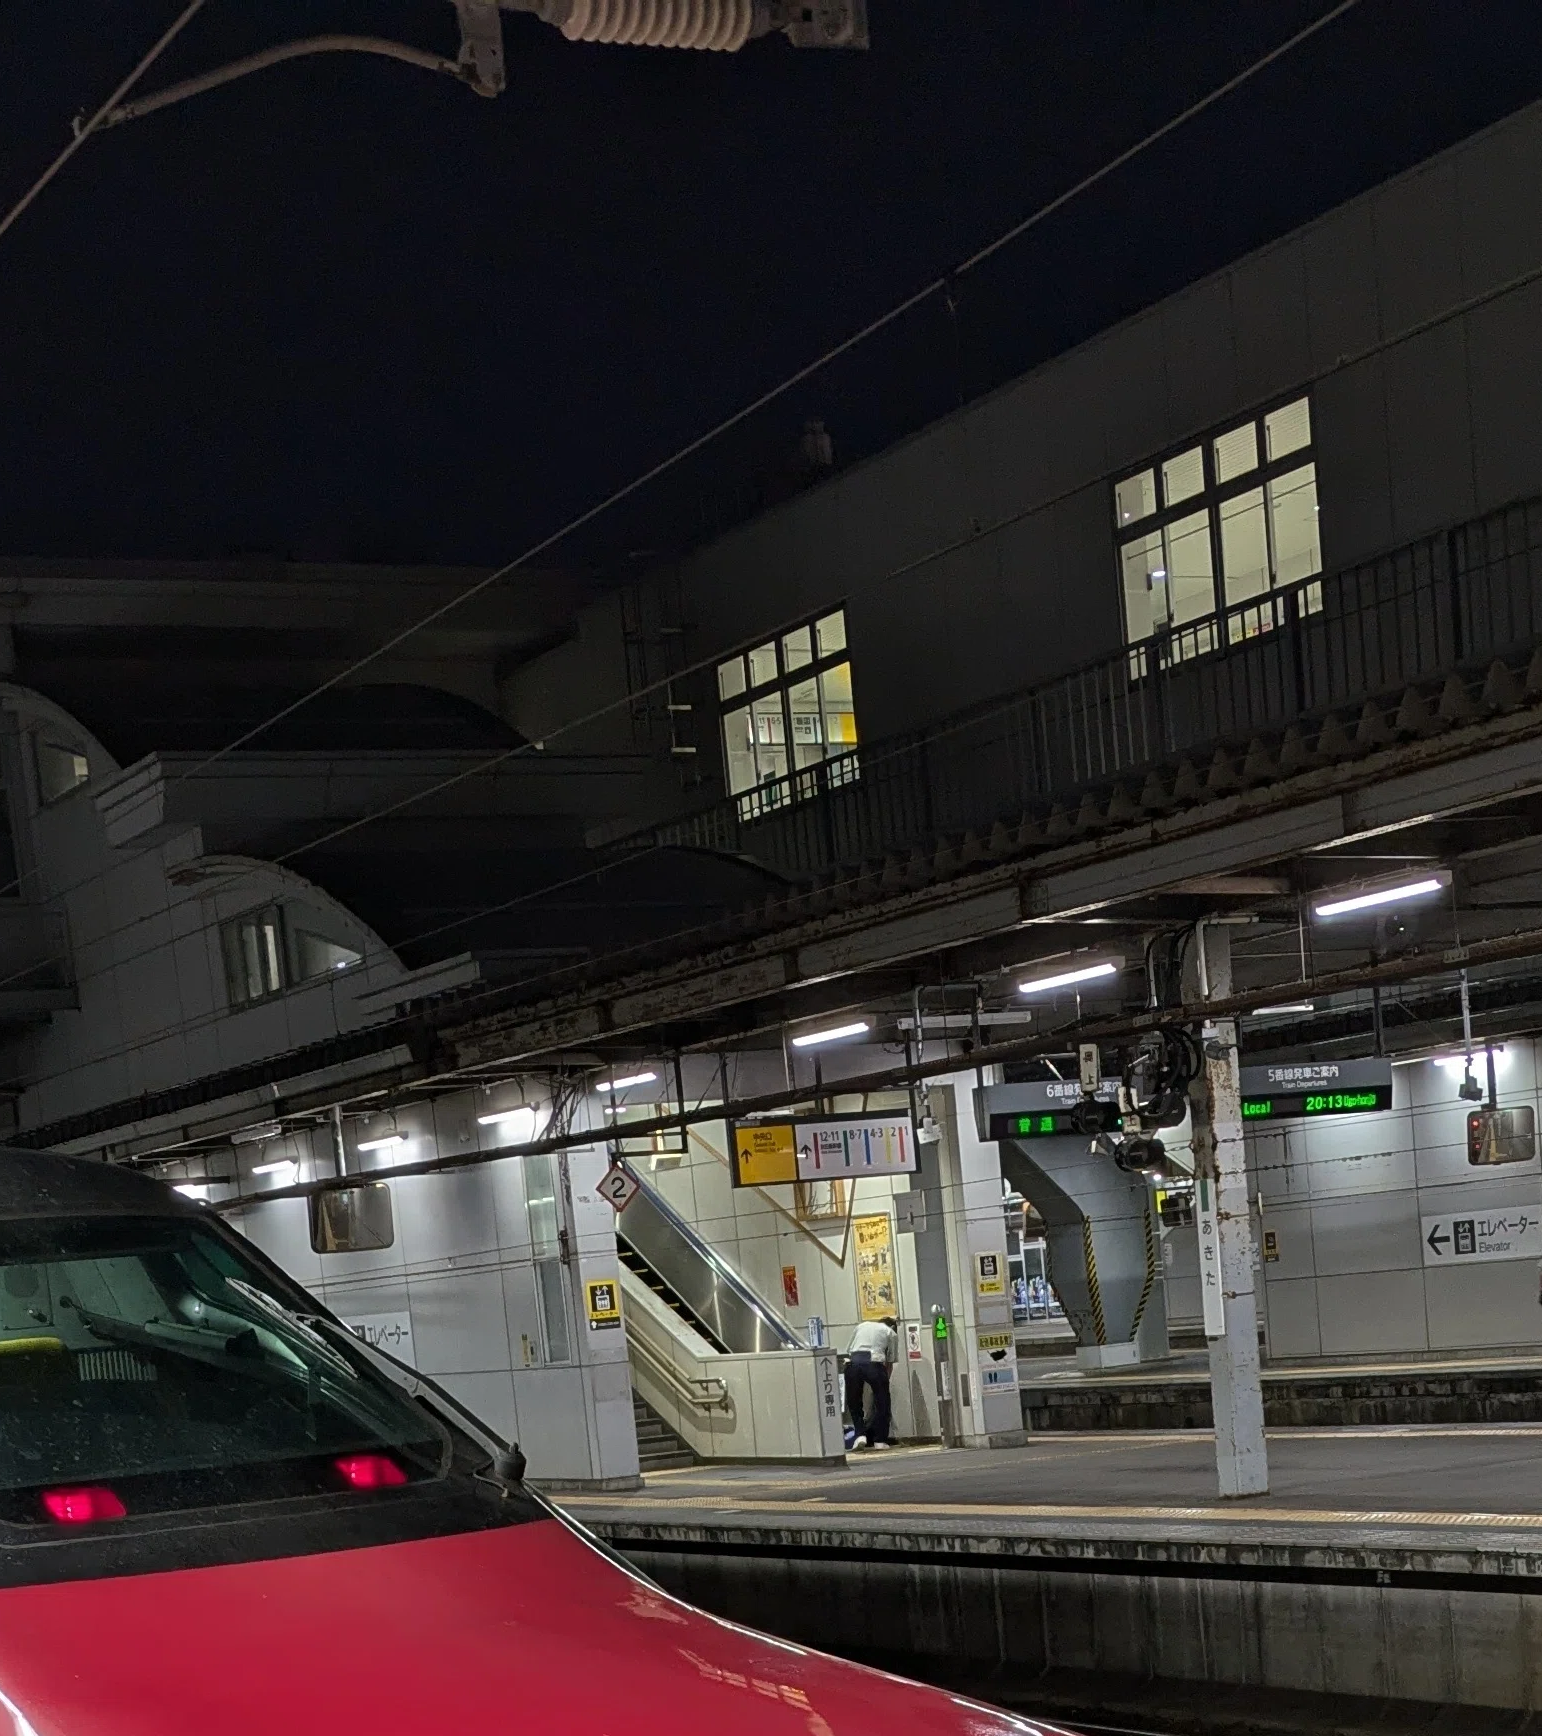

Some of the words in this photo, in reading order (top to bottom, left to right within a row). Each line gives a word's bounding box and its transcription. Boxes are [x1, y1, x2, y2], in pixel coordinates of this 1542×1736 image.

[1267, 1065, 1340, 1083] 5番線発車ご案内
[1243, 1101, 1271, 1116] Local
[1306, 1094, 1343, 1111] 20:13
[1018, 1116, 1054, 1133] 普通
[611, 1176, 627, 1199] 2
[1477, 1216, 1539, 1237] エレベーター
[1202, 1219, 1216, 1287] あきた
[1478, 1242, 1511, 1254] Elevator
[367, 1323, 409, 1346] エレベーター
[822, 1373, 836, 1418] 上り専用
